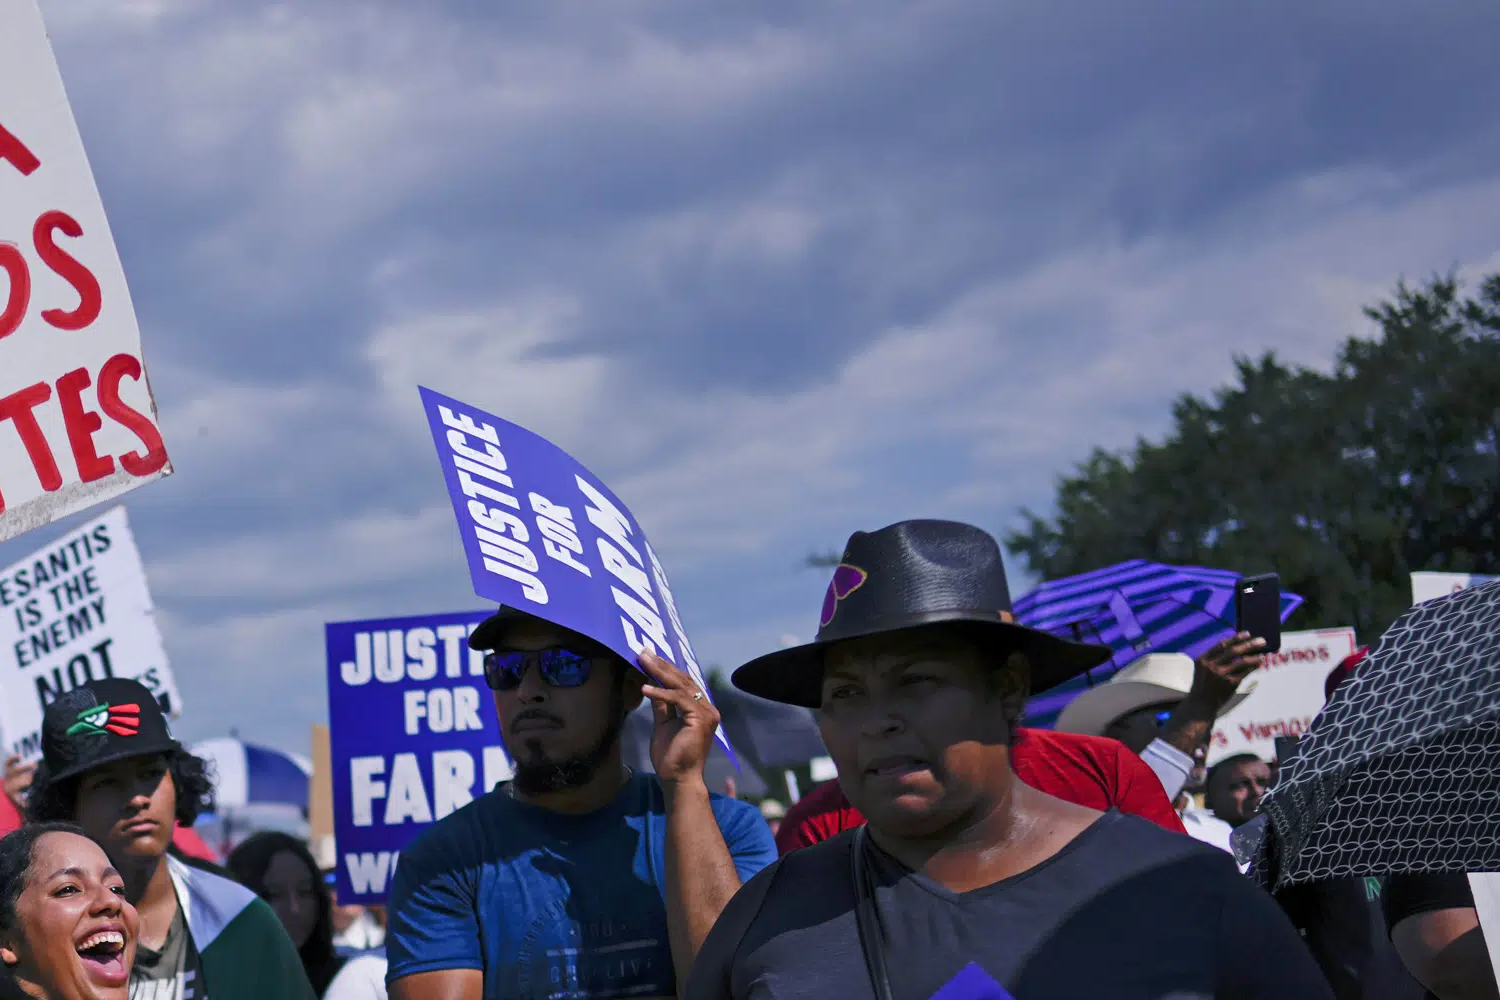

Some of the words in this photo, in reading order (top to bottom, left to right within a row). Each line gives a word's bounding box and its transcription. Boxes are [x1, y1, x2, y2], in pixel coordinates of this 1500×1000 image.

[436, 403, 549, 605] JUSTICE
[527, 490, 592, 578] FOR
[13, 596, 108, 669] ENEMY
[14, 598, 44, 633] IS
[50, 565, 102, 612] THE
[34, 637, 115, 712] NOT
[340, 622, 494, 686] JUSTI
[402, 685, 484, 736] FOR
